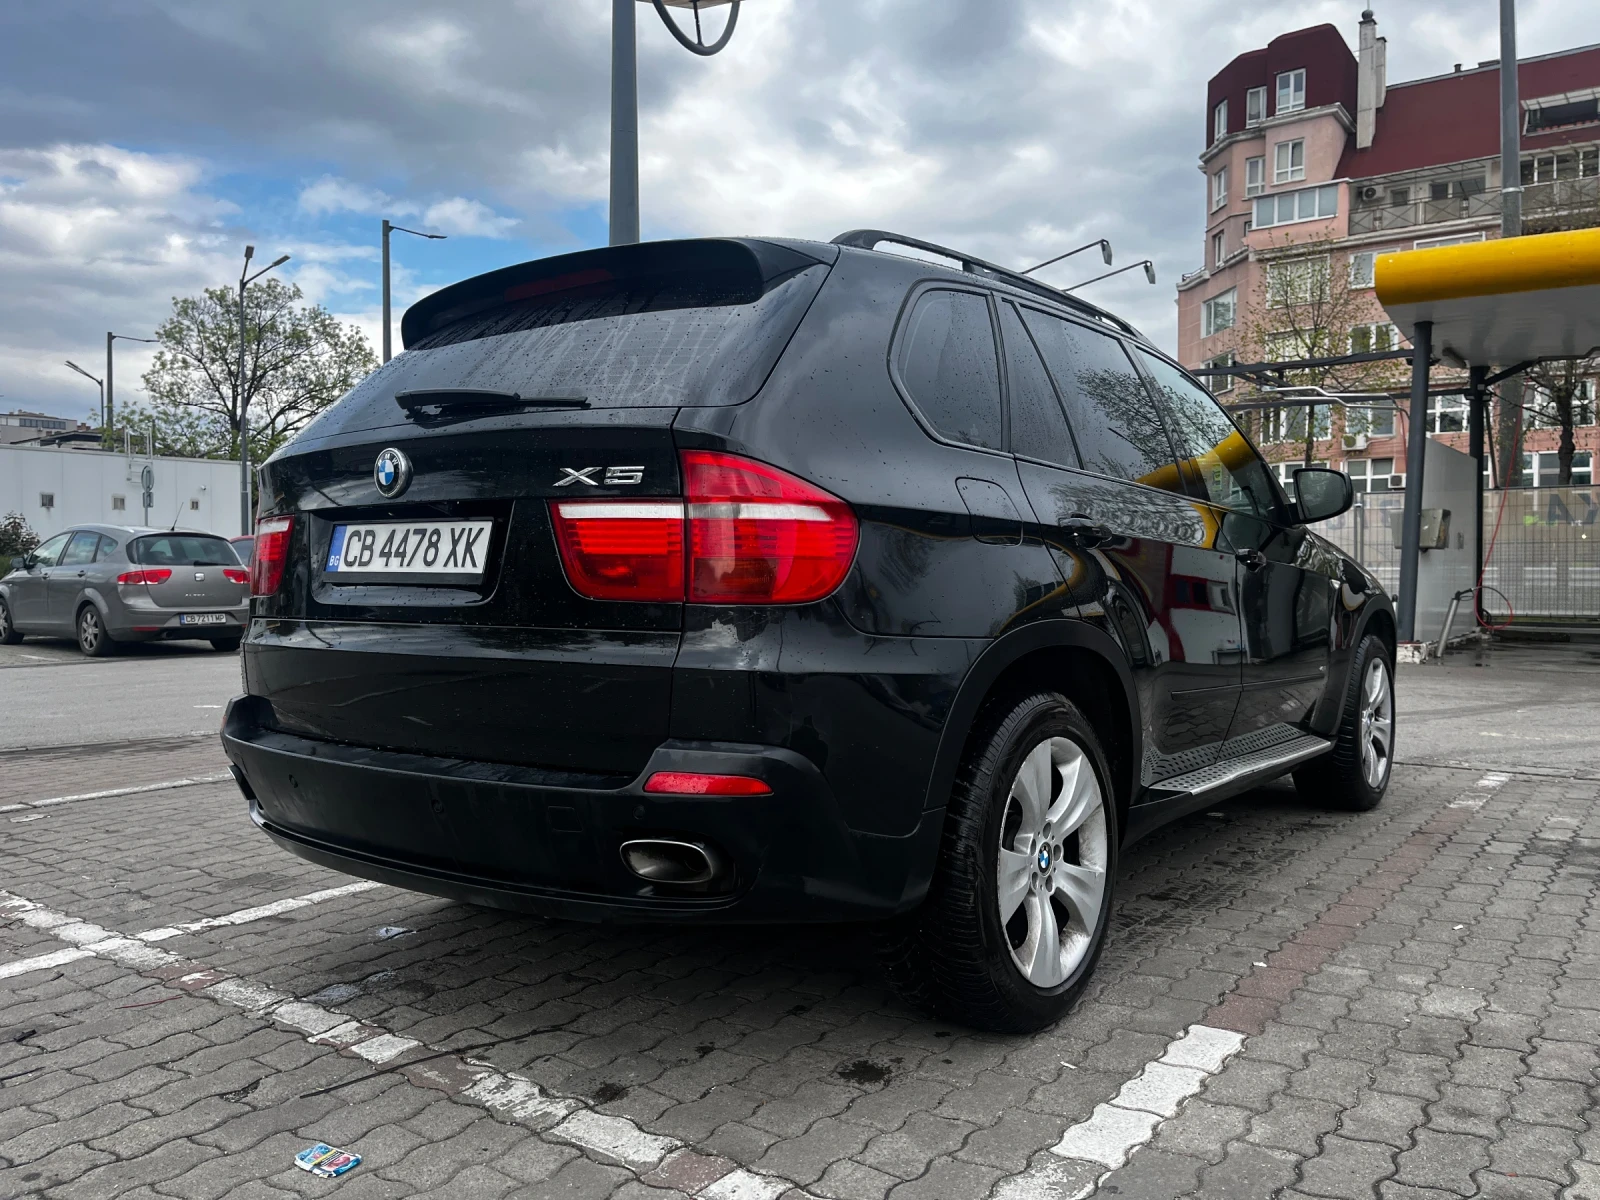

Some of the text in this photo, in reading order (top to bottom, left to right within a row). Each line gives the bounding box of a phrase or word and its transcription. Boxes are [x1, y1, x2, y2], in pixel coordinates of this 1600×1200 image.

[552, 466, 645, 486] X5
[343, 527, 484, 567] CB 4478 XK
[328, 555, 340, 566] BG
